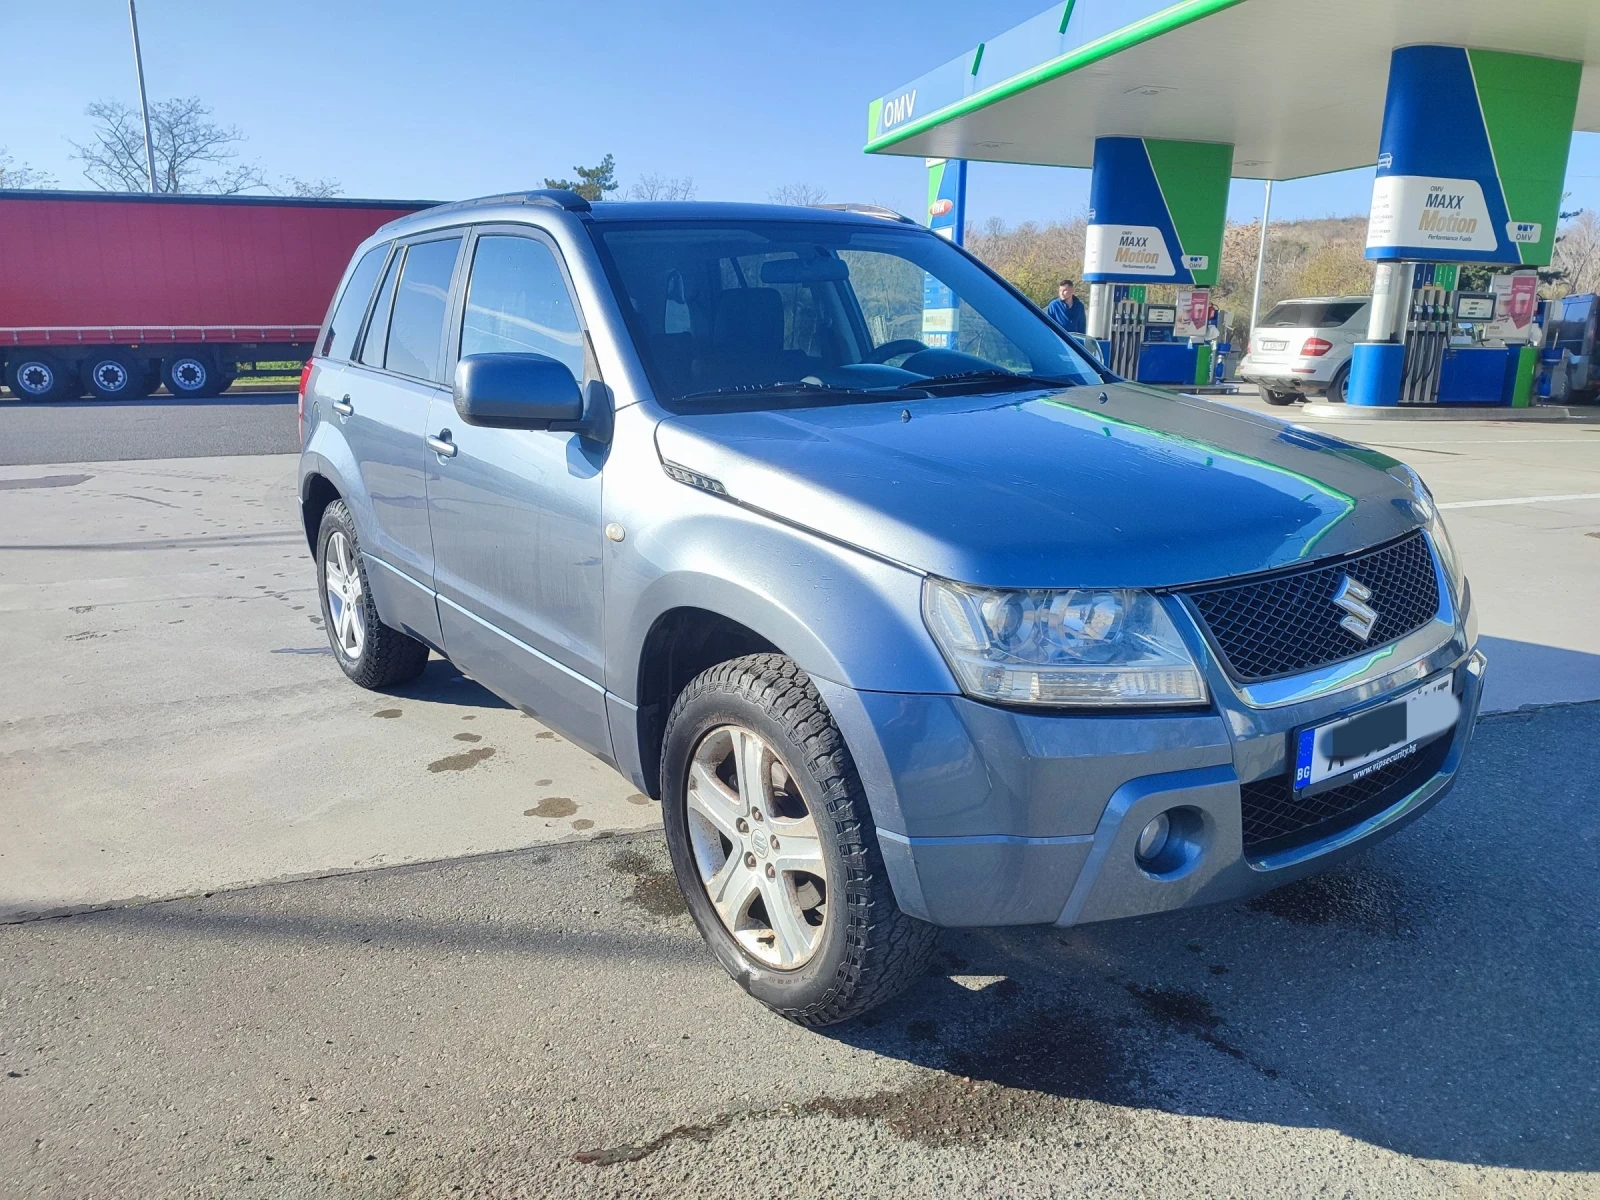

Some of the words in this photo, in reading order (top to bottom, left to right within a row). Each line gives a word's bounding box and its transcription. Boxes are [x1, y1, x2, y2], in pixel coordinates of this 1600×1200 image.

[884, 89, 917, 128] OMV
[1425, 193, 1464, 209] MAXX
[1418, 209, 1478, 233] Motion
[1119, 236, 1148, 247] MAXX
[1515, 233, 1533, 241] OMV
[1114, 247, 1160, 264] Motion
[1352, 743, 1417, 780] www.vipsecurity.bg
[1296, 766, 1311, 781] BG
